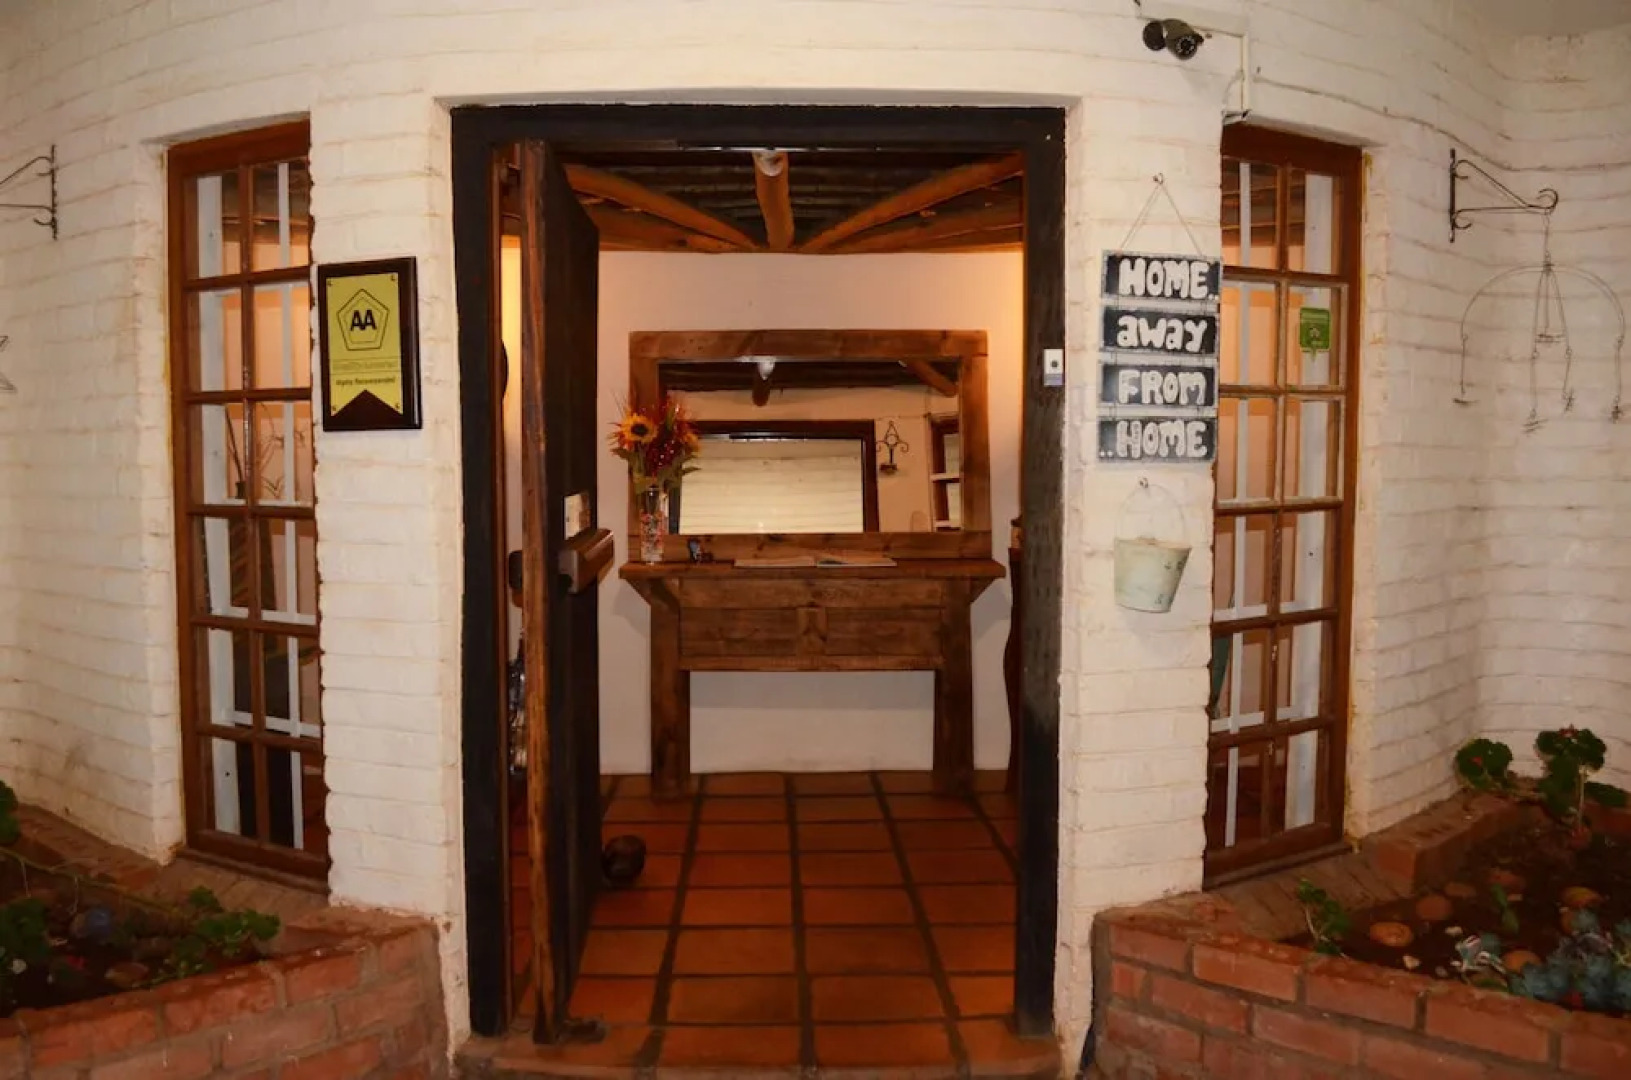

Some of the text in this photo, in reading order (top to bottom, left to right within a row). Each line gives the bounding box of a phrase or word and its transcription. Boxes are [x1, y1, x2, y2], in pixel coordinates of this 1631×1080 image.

[350, 309, 377, 332] AA
[1117, 316, 1207, 352] away
[1118, 369, 1206, 405] FROM
